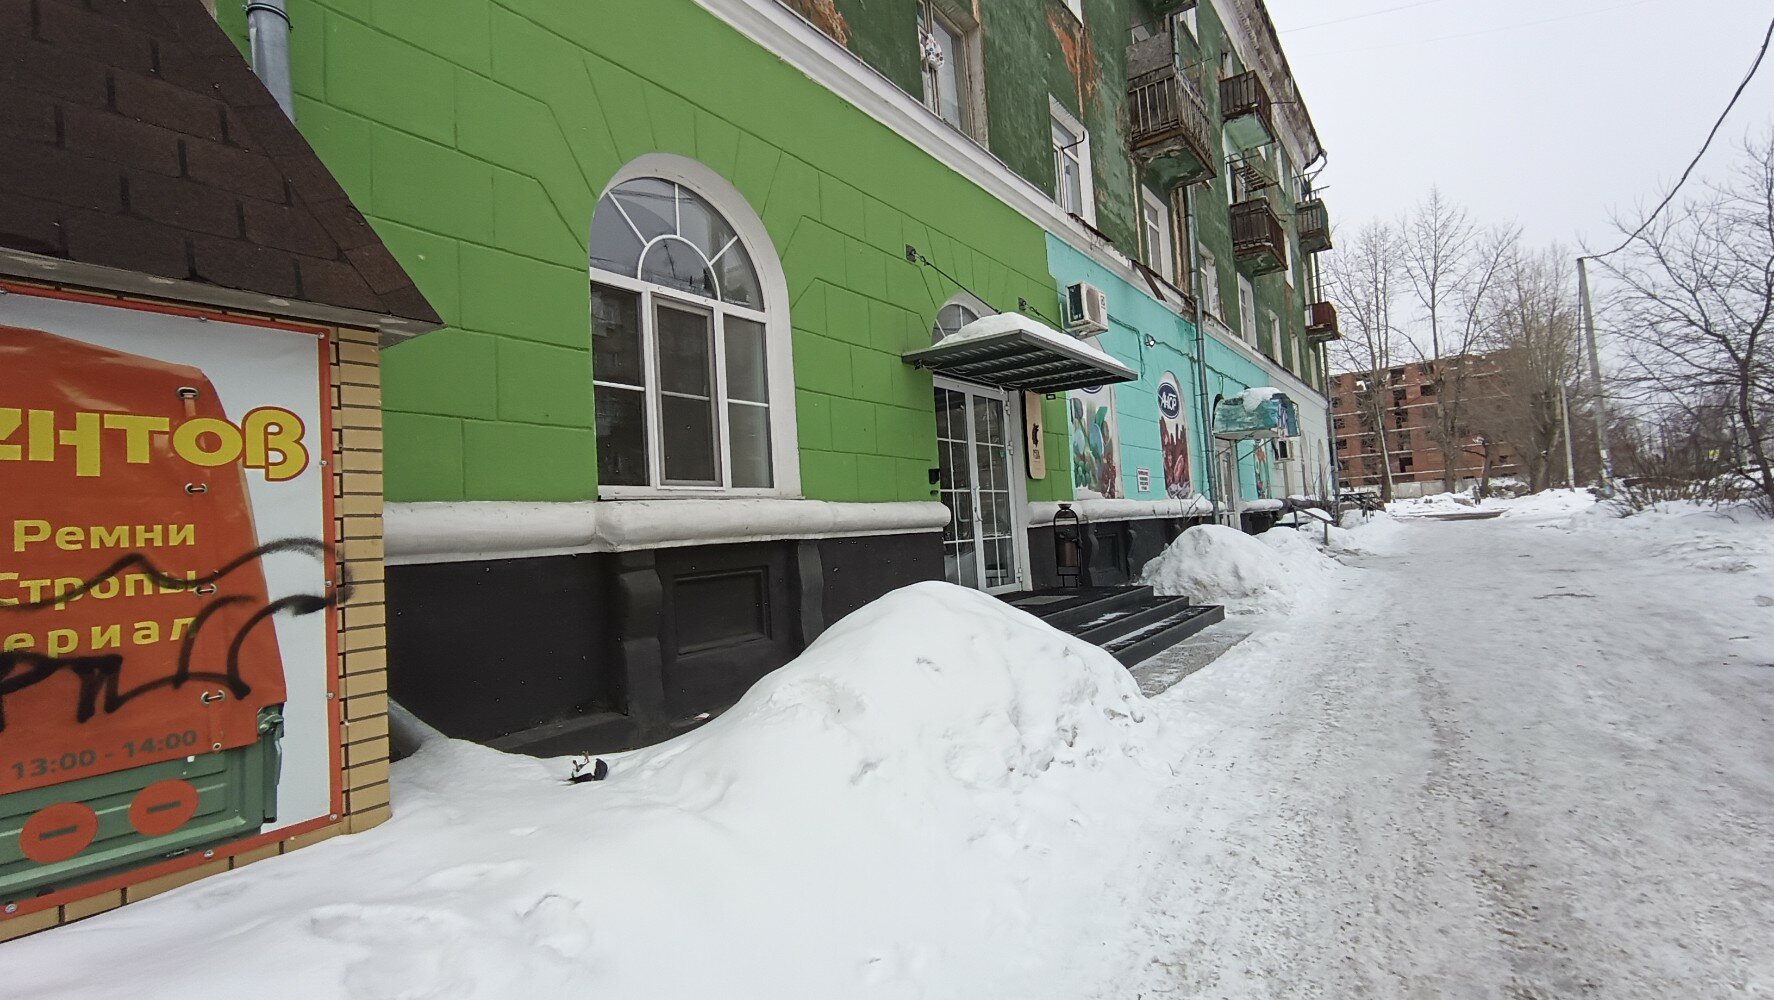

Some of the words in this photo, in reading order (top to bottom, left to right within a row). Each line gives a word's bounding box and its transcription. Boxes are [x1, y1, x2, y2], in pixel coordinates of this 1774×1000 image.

[13, 519, 195, 552] Ремни
[12, 749, 97, 779] 13:00
[122, 729, 198, 758] 14:00
